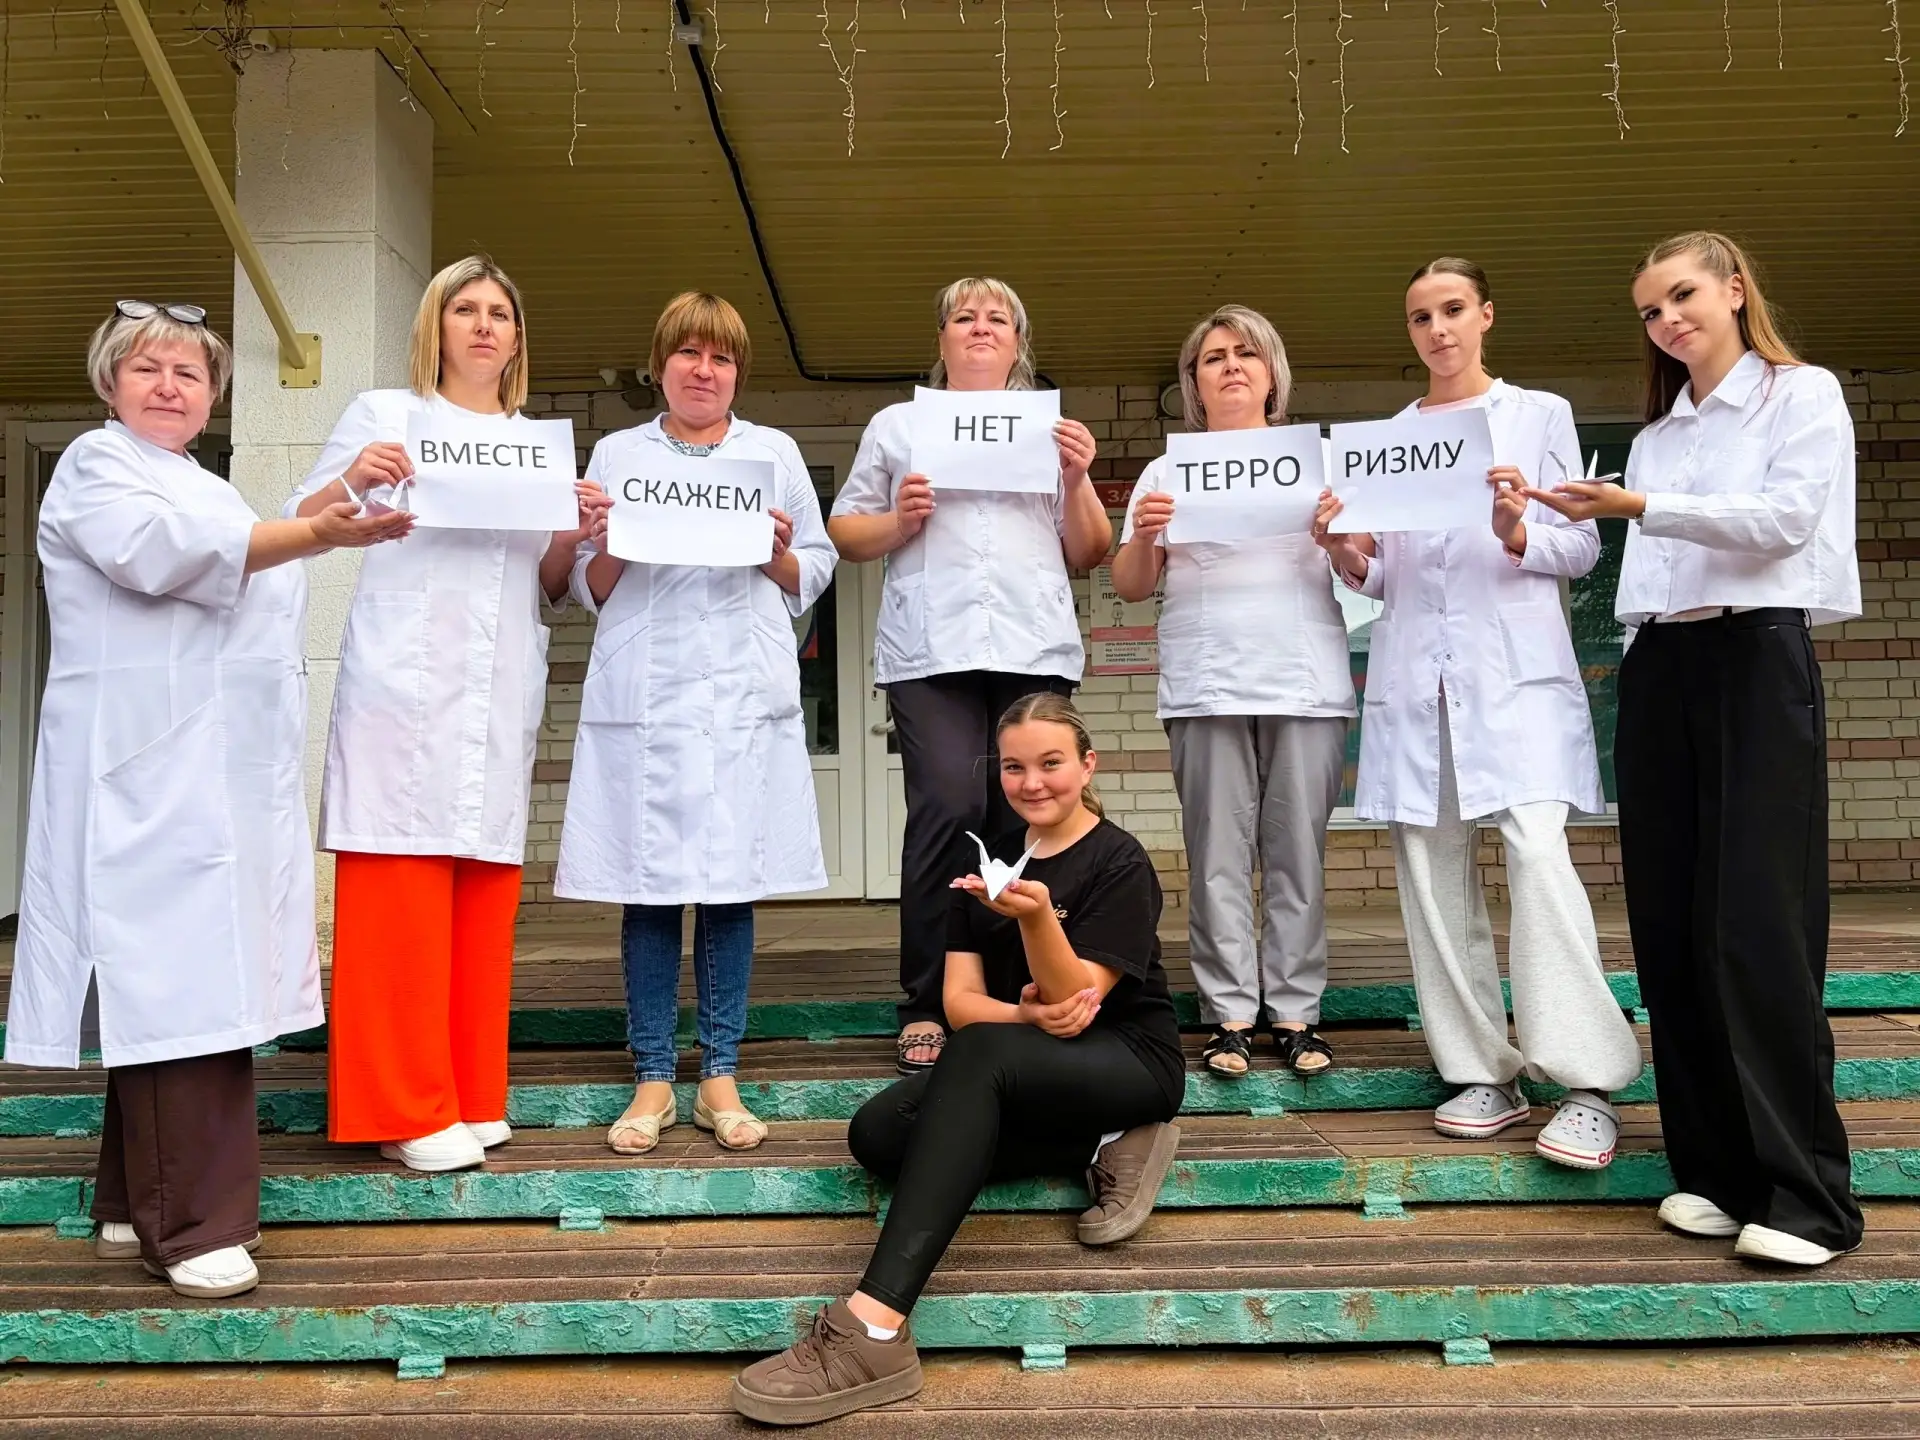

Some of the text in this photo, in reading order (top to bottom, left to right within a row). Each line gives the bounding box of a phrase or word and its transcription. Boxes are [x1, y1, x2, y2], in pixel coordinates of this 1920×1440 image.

[954, 415, 1022, 443] НЕТ
[421, 439, 547, 469] ВМЕСТЕ
[1345, 438, 1465, 478] РИЗМУ
[1176, 455, 1301, 493] ТЕРРО
[623, 478, 762, 513] СКАЖЕМ
